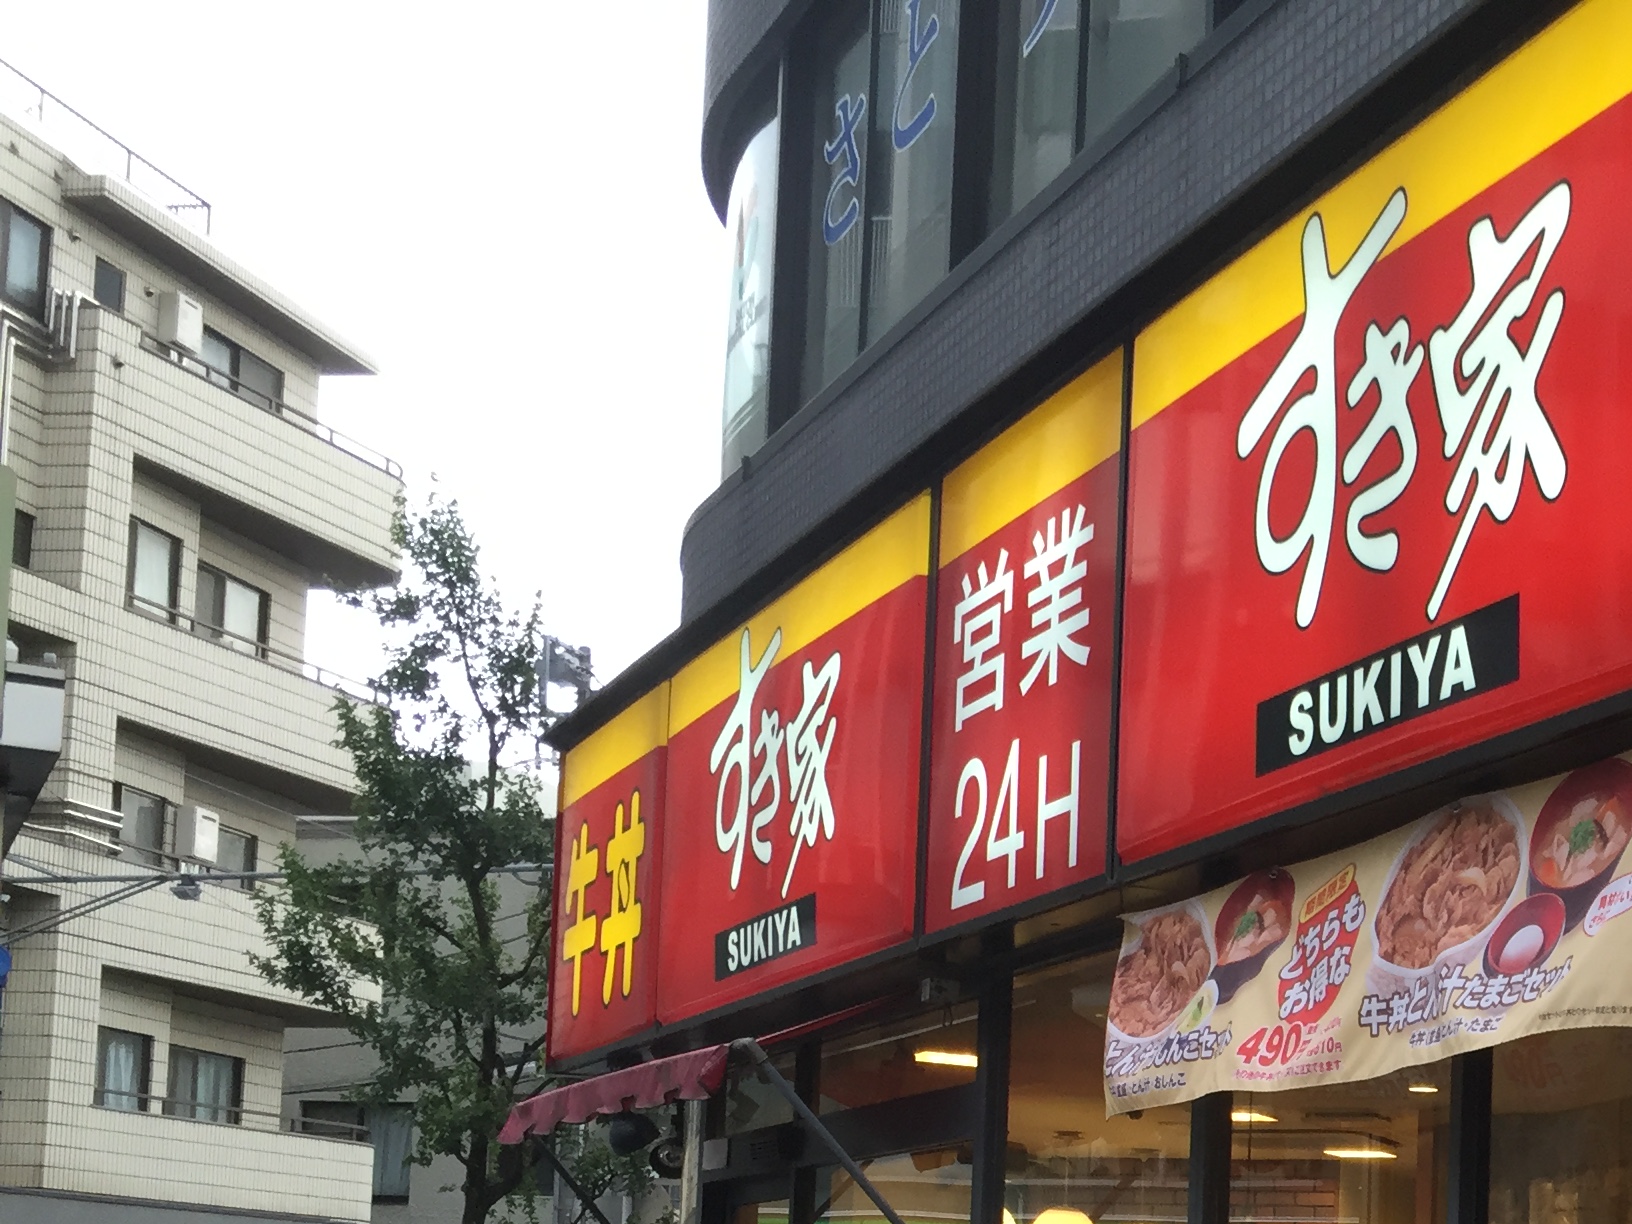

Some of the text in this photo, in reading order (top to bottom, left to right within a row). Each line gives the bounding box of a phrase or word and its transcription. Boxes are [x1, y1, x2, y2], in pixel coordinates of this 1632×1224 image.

[1236, 178, 1571, 629] すき家
[953, 503, 1095, 732] 営業
[1287, 624, 1477, 756] SUKIYA
[709, 626, 842, 899] すき家
[951, 738, 1081, 911] 24H
[562, 788, 646, 1018] 牛丼
[726, 905, 802, 972] SUKIYA
[1279, 893, 1367, 981] どちらも
[1279, 946, 1352, 1020] お得な
